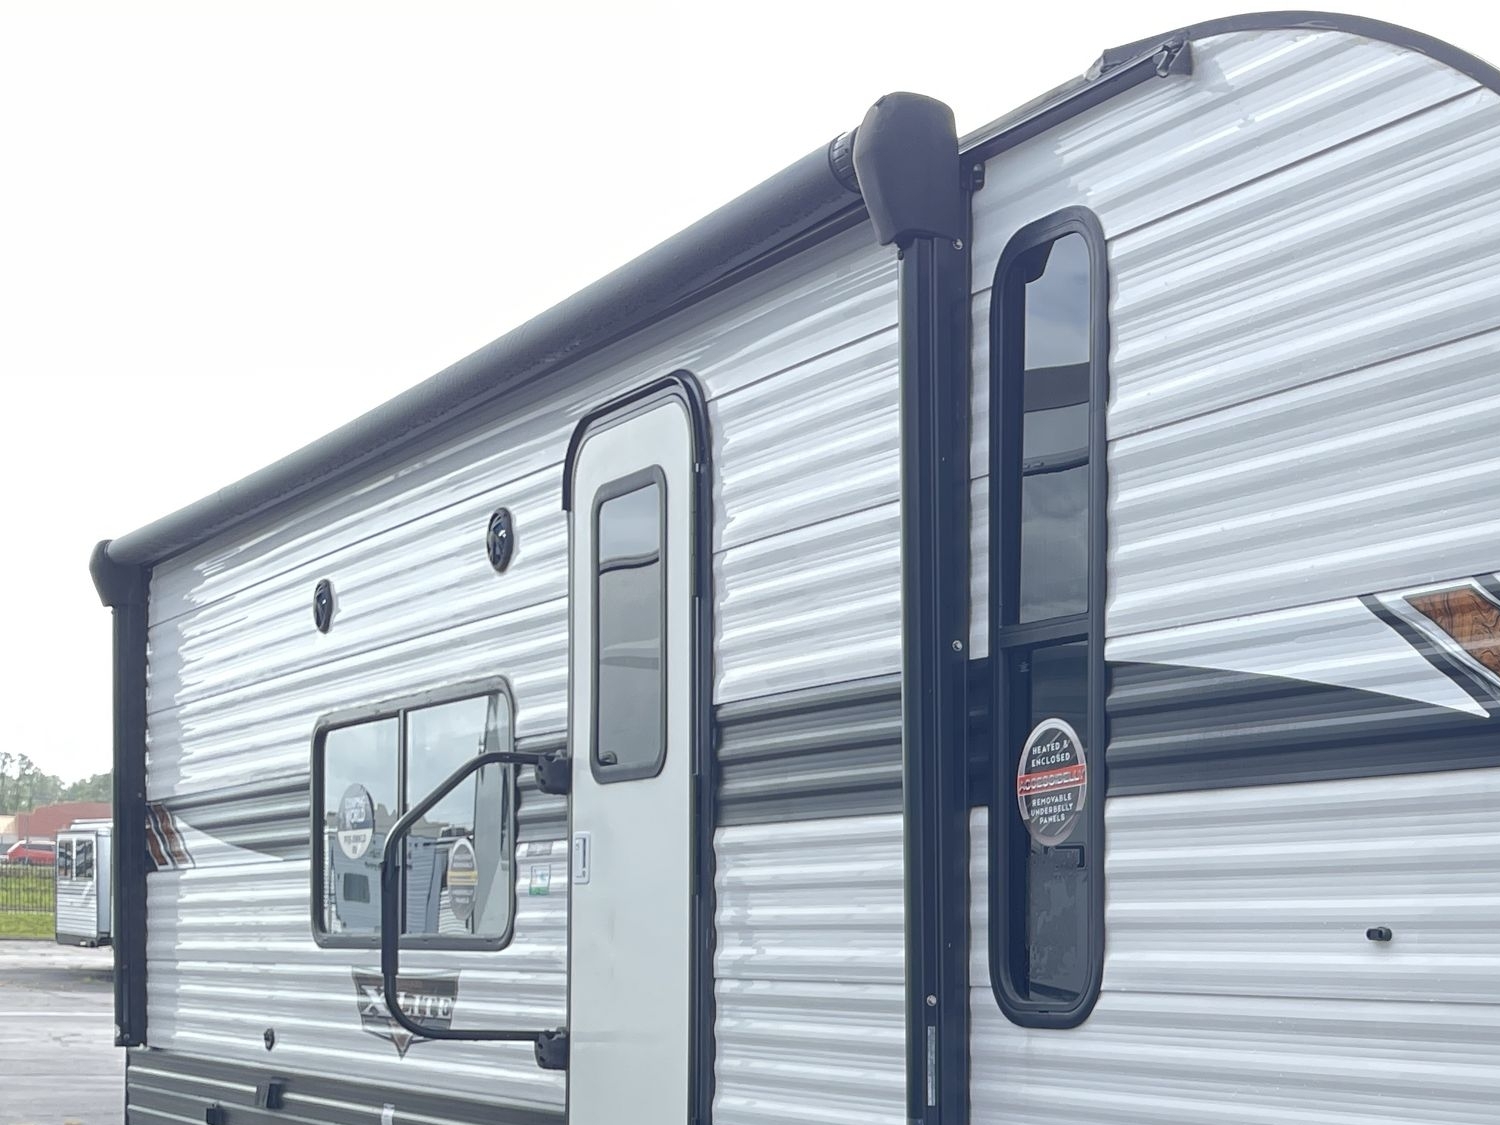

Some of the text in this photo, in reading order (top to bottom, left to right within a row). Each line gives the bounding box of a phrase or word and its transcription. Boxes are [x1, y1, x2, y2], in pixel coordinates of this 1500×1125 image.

[1032, 739, 1071, 755] HEATED &
[1031, 753, 1071, 768] ENCLOSED
[1031, 792, 1073, 807] REMOVABLE
[1030, 803, 1074, 817] UNDERBELLY
[1039, 813, 1066, 825] PANELS
